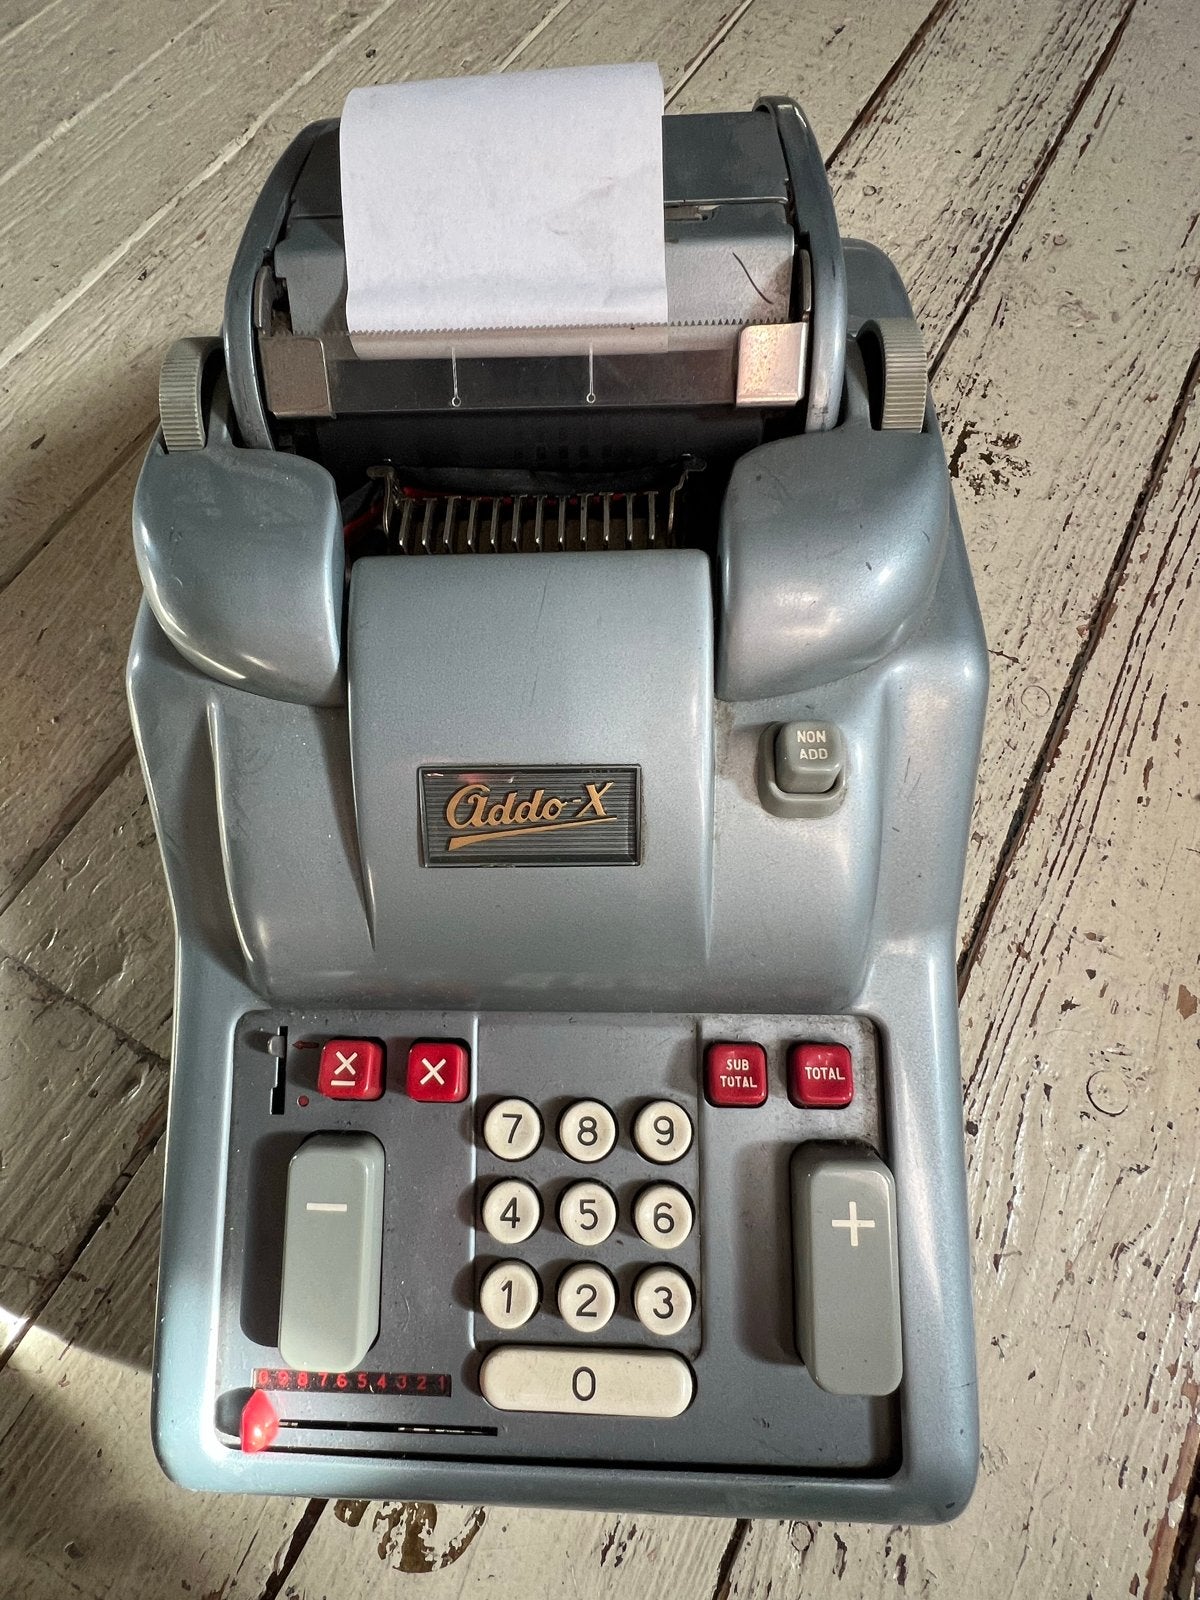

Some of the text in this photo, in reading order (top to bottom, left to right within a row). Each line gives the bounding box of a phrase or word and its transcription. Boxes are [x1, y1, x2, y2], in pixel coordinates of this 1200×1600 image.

[796, 729, 827, 743] NON
[799, 748, 829, 760] ADD
[725, 1058, 750, 1071] SUB
[804, 1066, 846, 1080] TOTAL
[719, 1074, 758, 1088] TOTAL
[502, 1113, 675, 1146] 7 8 9
[500, 1197, 675, 1234] 4 5 6
[500, 1279, 674, 1319] 1 2 3
[572, 1366, 596, 1402] 0
